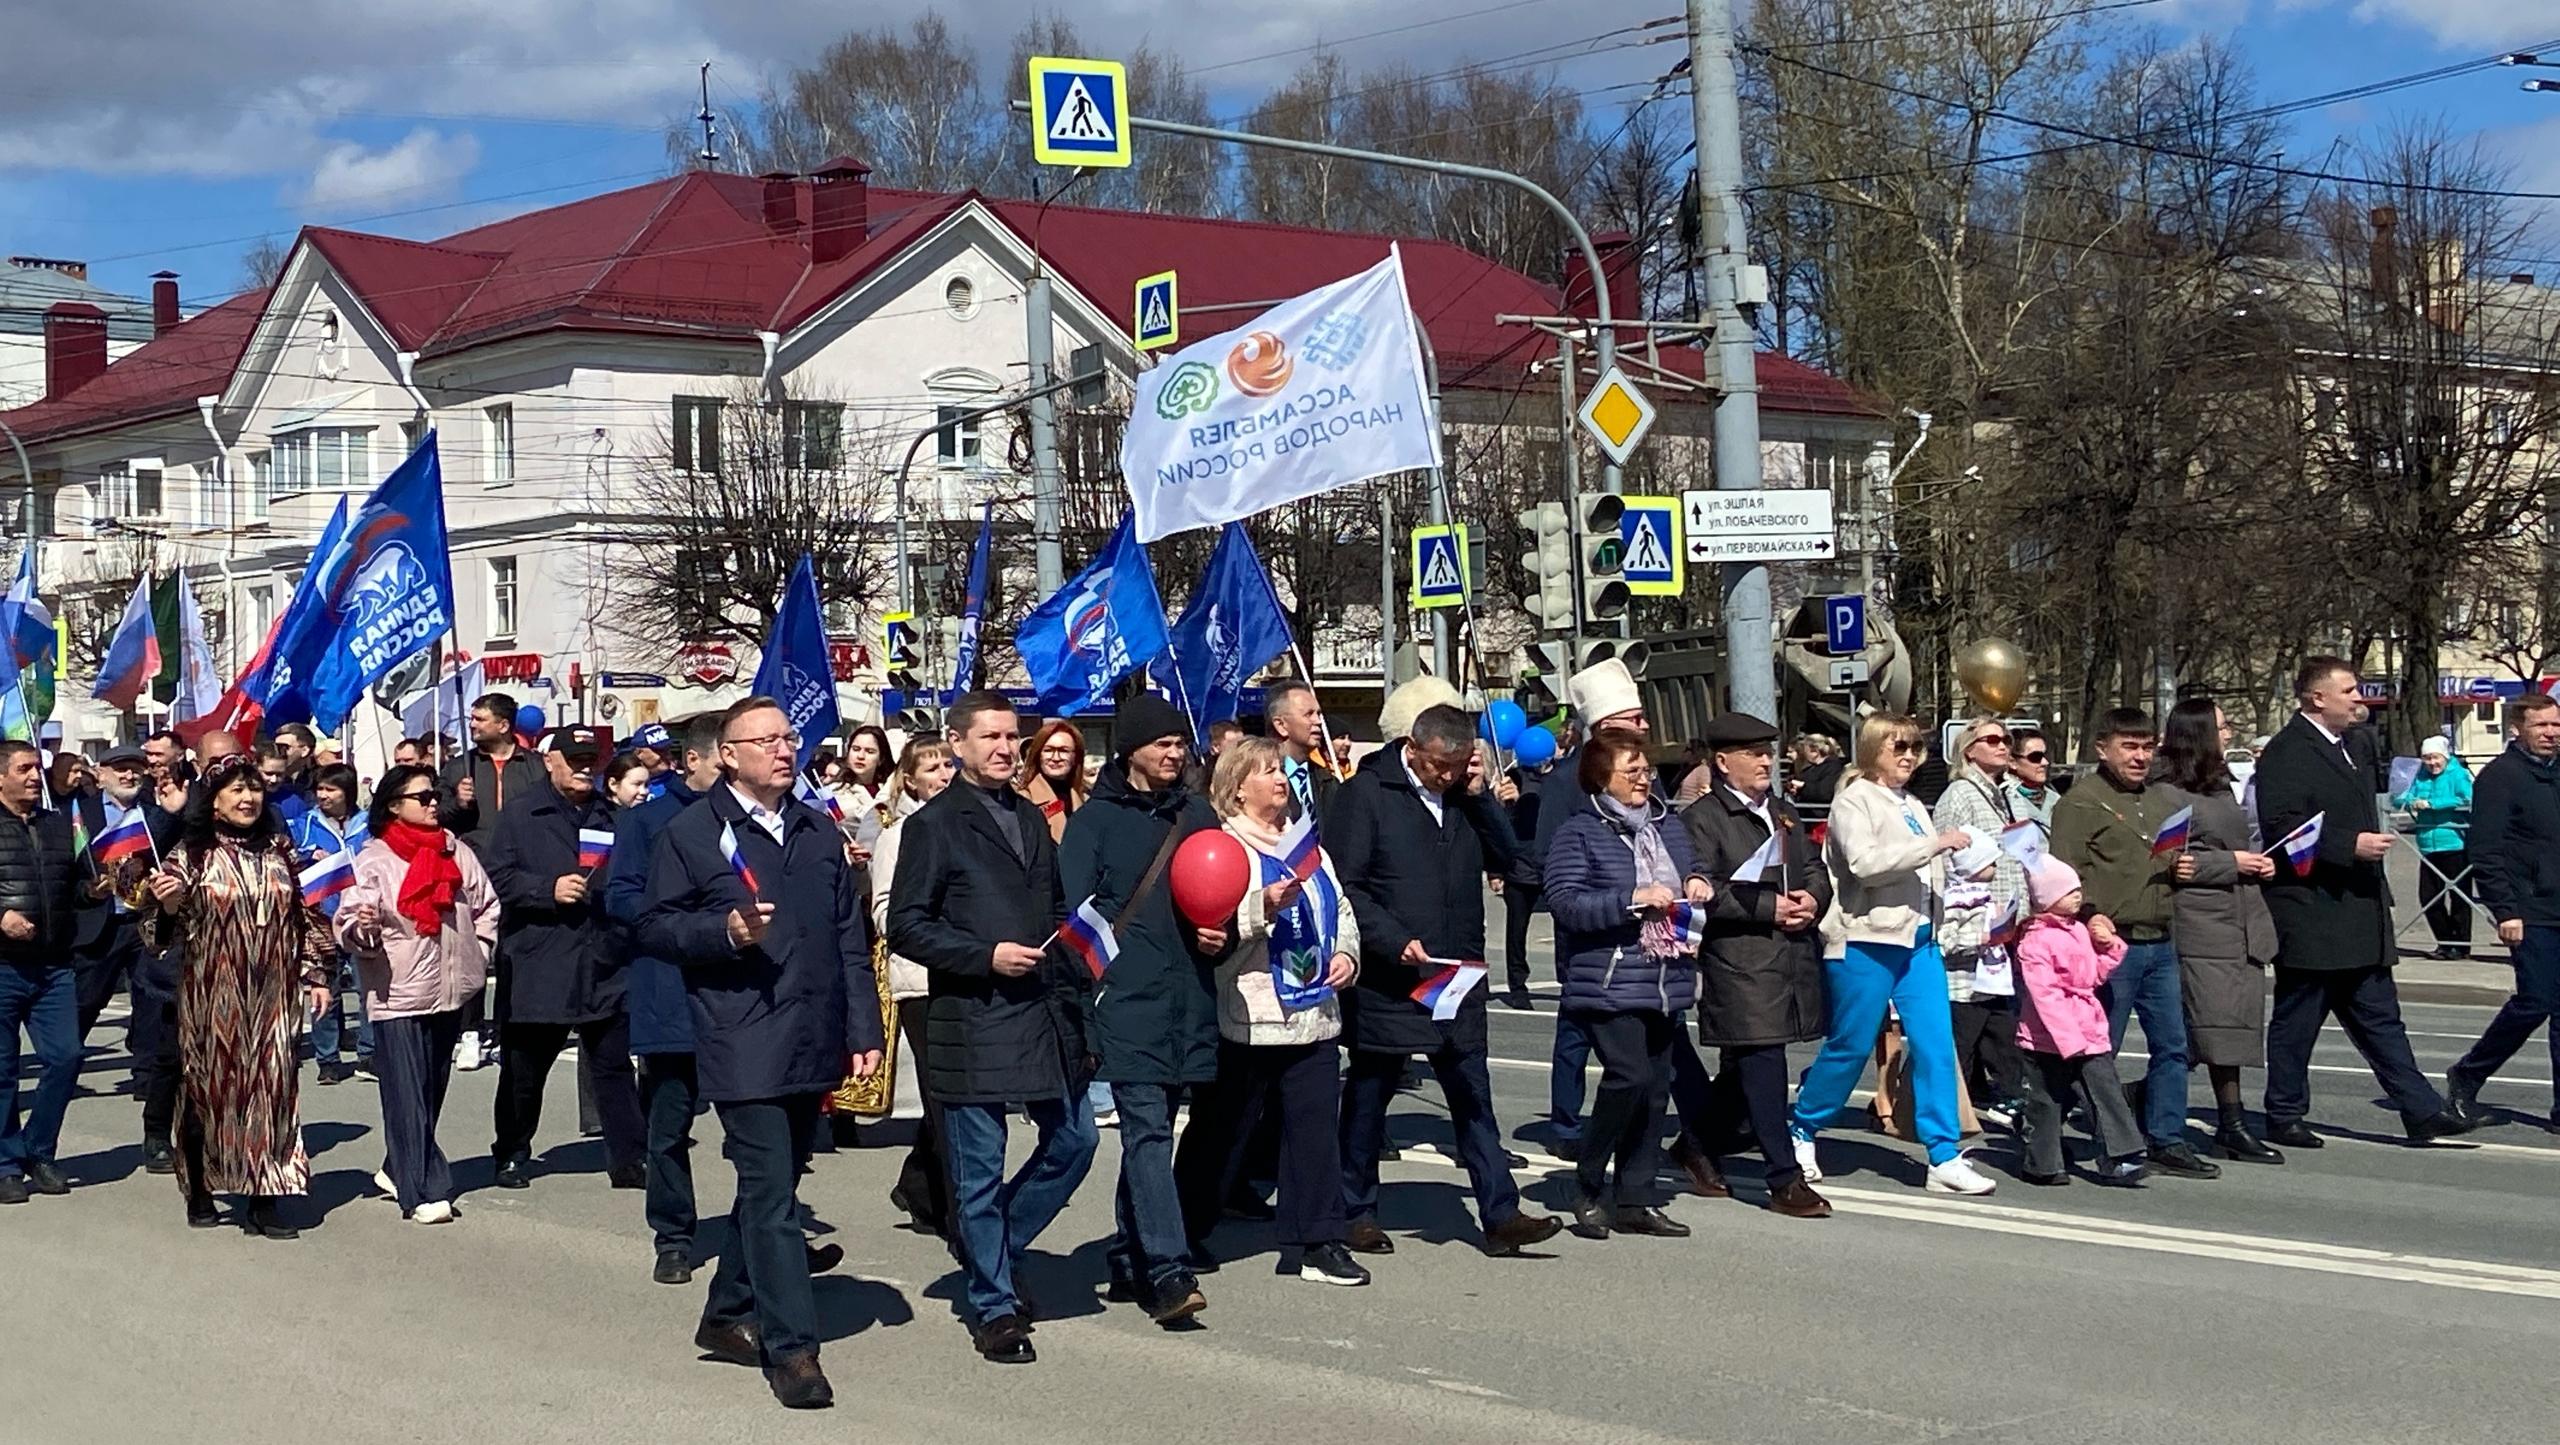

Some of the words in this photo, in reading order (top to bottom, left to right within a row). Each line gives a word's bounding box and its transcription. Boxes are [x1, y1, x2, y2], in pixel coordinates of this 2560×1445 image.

[1707, 500, 1722, 513] ул.
[1724, 498, 1765, 510] ЭШПАЯ
[1709, 518, 1724, 530] ул.
[1725, 514, 1809, 527] ЛОБАЧЕВСКОГО
[1711, 545, 1726, 557] ул.
[1726, 541, 1814, 554] ПЕРВОМАЙСКАЯ
[1835, 605, 1855, 644] P
